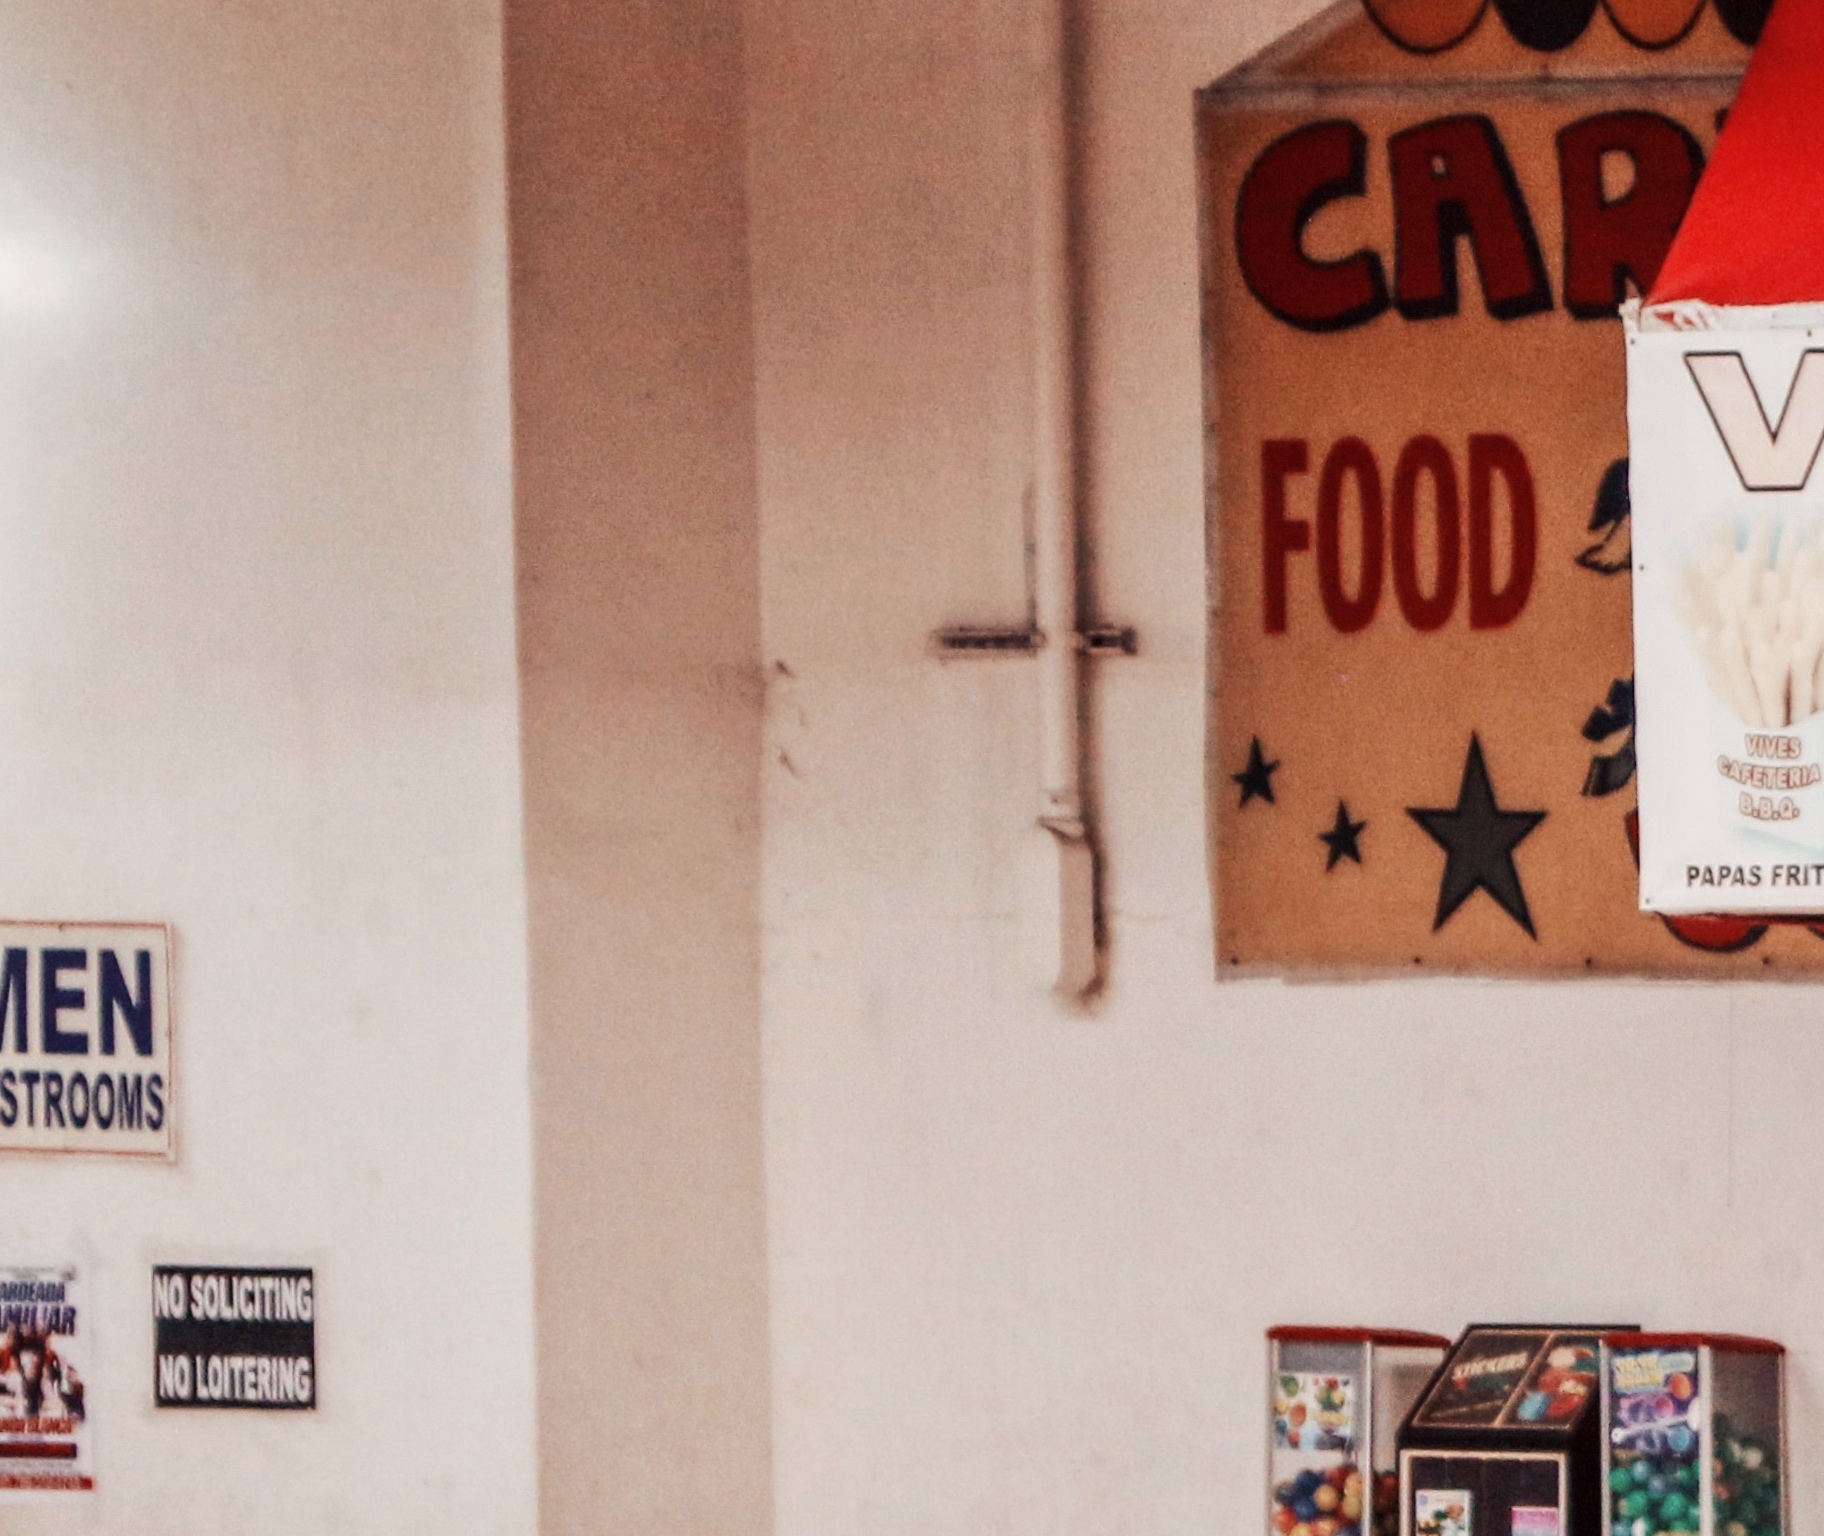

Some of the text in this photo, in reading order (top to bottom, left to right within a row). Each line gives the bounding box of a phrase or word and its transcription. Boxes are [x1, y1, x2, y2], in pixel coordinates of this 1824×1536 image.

[1235, 110, 1728, 334] CAR
[1259, 433, 1538, 634] FOOD
[1744, 733, 1802, 759] VIVES
[1717, 754, 1821, 790] CAFETERIA
[1739, 791, 1801, 821] B.B.Q.
[1686, 865, 1762, 887] PAPAS
[154, 1273, 313, 1322] NO SOLICITING
[158, 1354, 311, 1403] NO LOITERING
